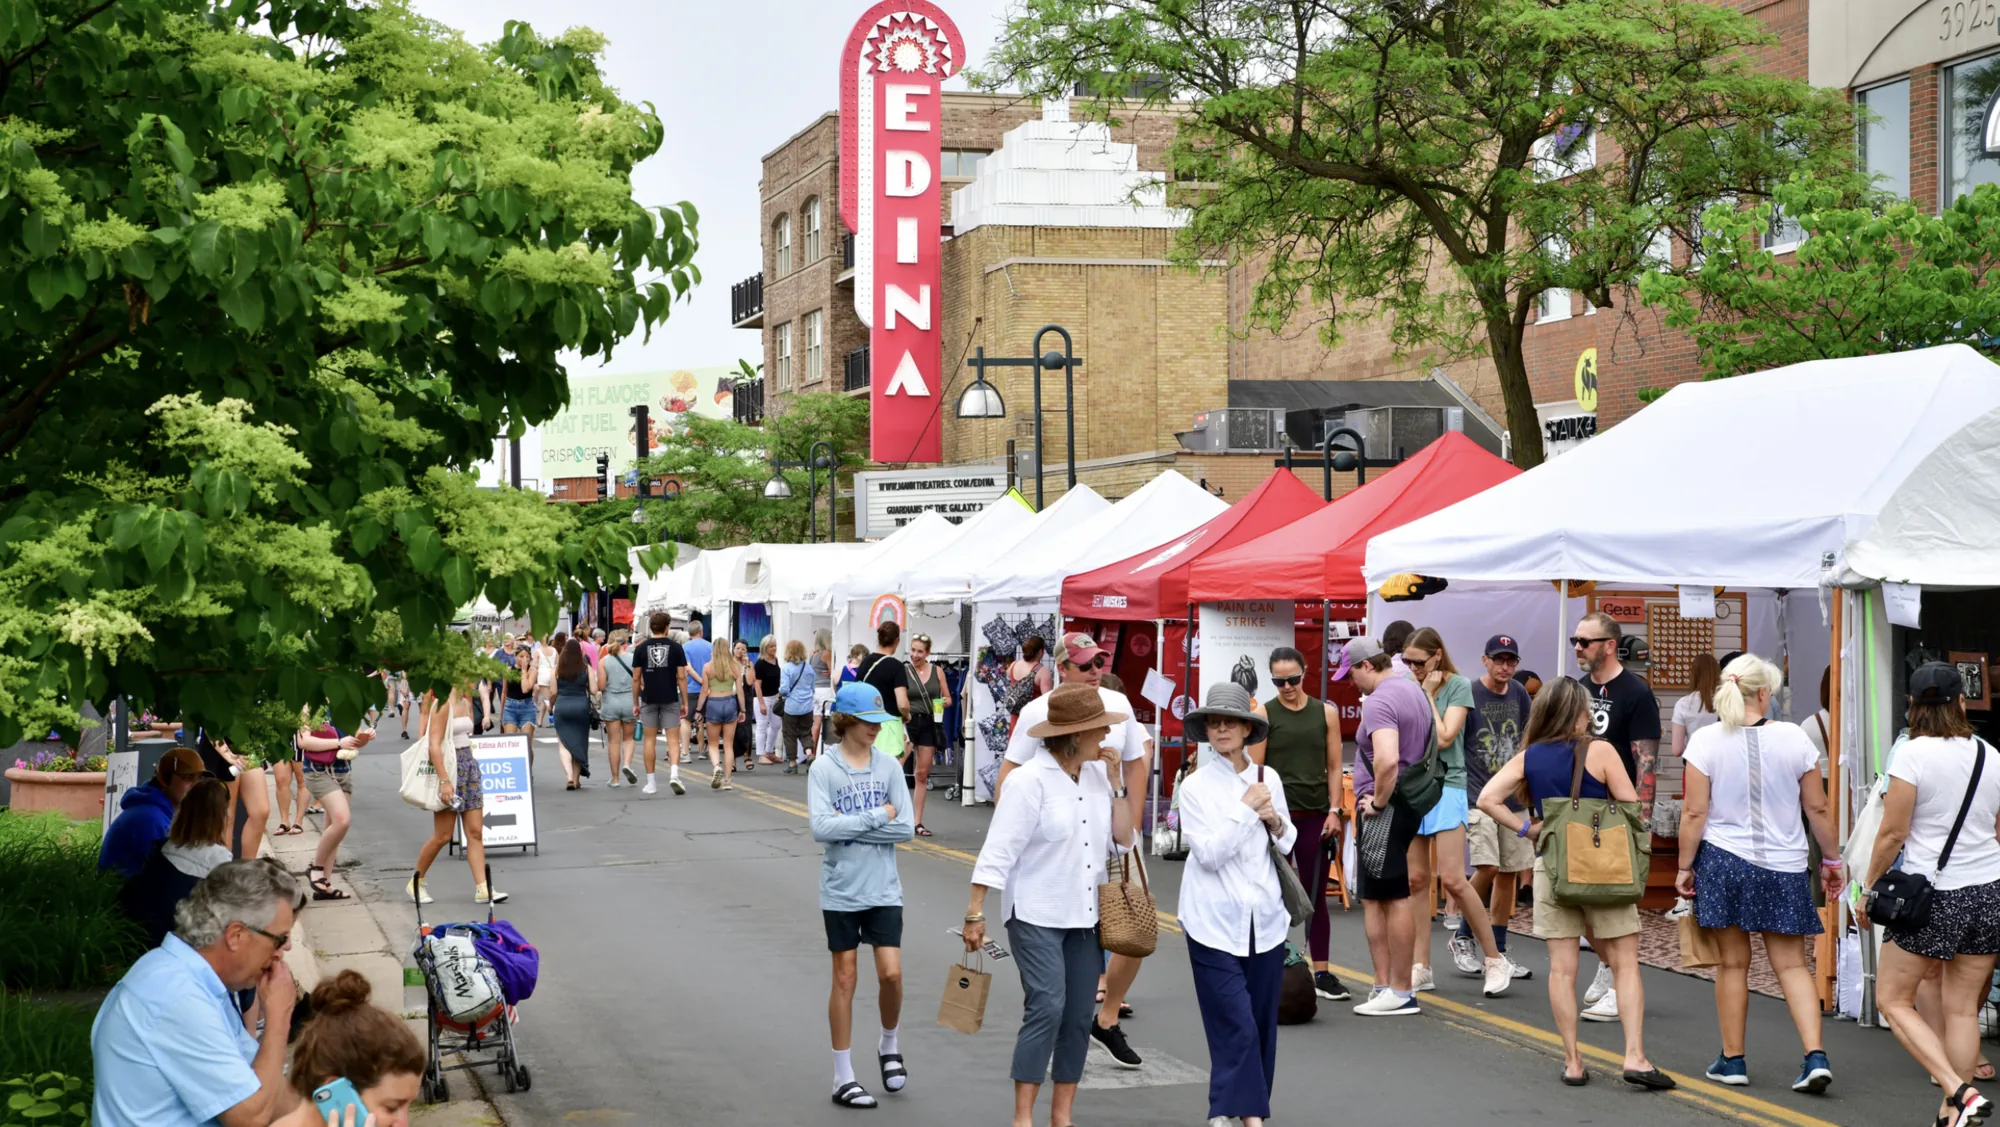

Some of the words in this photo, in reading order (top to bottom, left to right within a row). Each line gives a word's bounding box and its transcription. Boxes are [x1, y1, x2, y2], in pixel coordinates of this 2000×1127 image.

[1939, 0, 1996, 41] 3925
[885, 83, 931, 396] EDINA
[588, 383, 650, 406] FLAVORS
[581, 412, 617, 433] FUEL
[887, 505, 922, 515] GUARDIANS
[935, 504, 948, 513] THE
[949, 503, 976, 512] GALAXY
[978, 503, 984, 512] 3
[1217, 602, 1245, 613] PAIN
[1250, 602, 1275, 613] CAN
[1603, 603, 1641, 616] Gear
[1225, 617, 1266, 627] STRIKE
[497, 741, 506, 749] Art
[507, 740, 520, 748] Fair
[479, 762, 513, 775] KIDS
[482, 777, 517, 790] ONE
